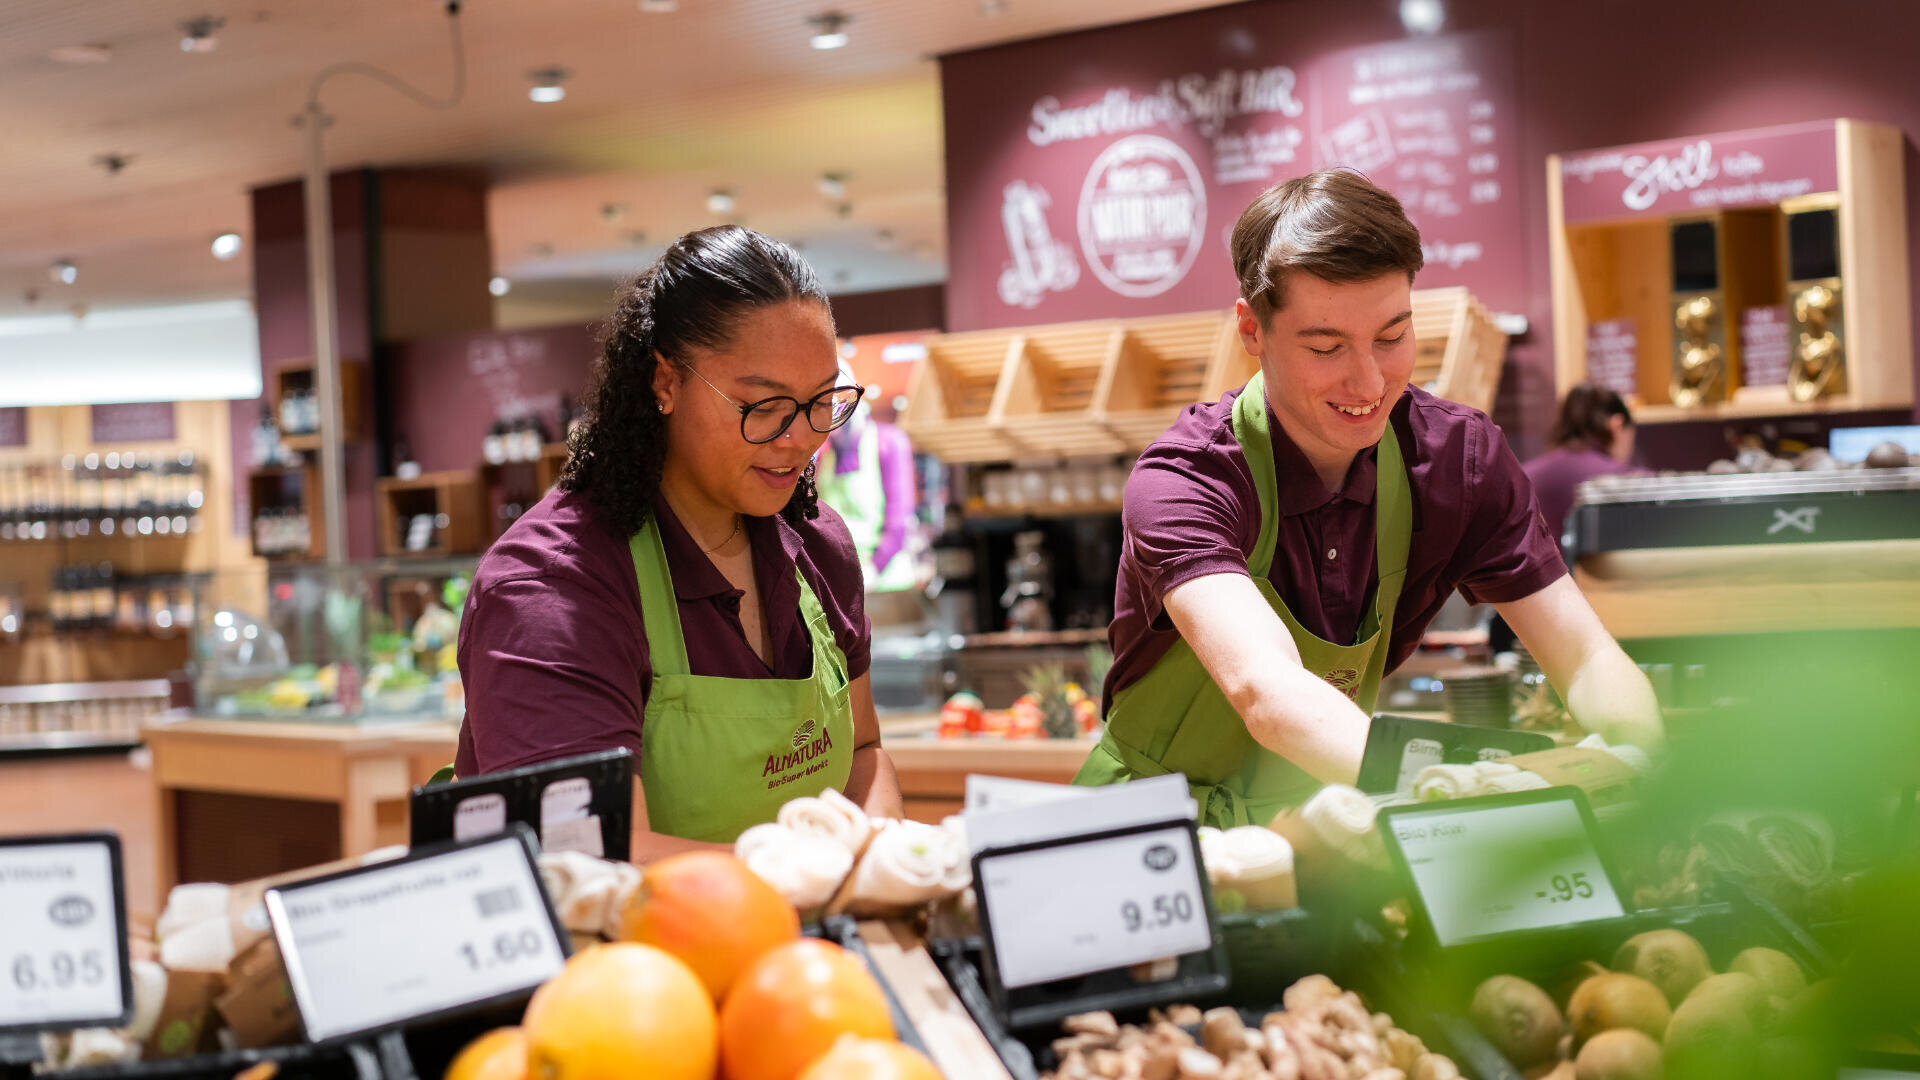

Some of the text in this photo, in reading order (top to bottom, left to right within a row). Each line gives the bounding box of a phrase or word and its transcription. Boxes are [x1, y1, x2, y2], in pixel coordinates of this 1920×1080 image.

[762, 727, 833, 777] ALNATURA
[1535, 871, 1594, 904] -.95
[1120, 890, 1193, 934] 9.50
[461, 927, 543, 970] 1.60
[12, 949, 105, 993] 6.95
